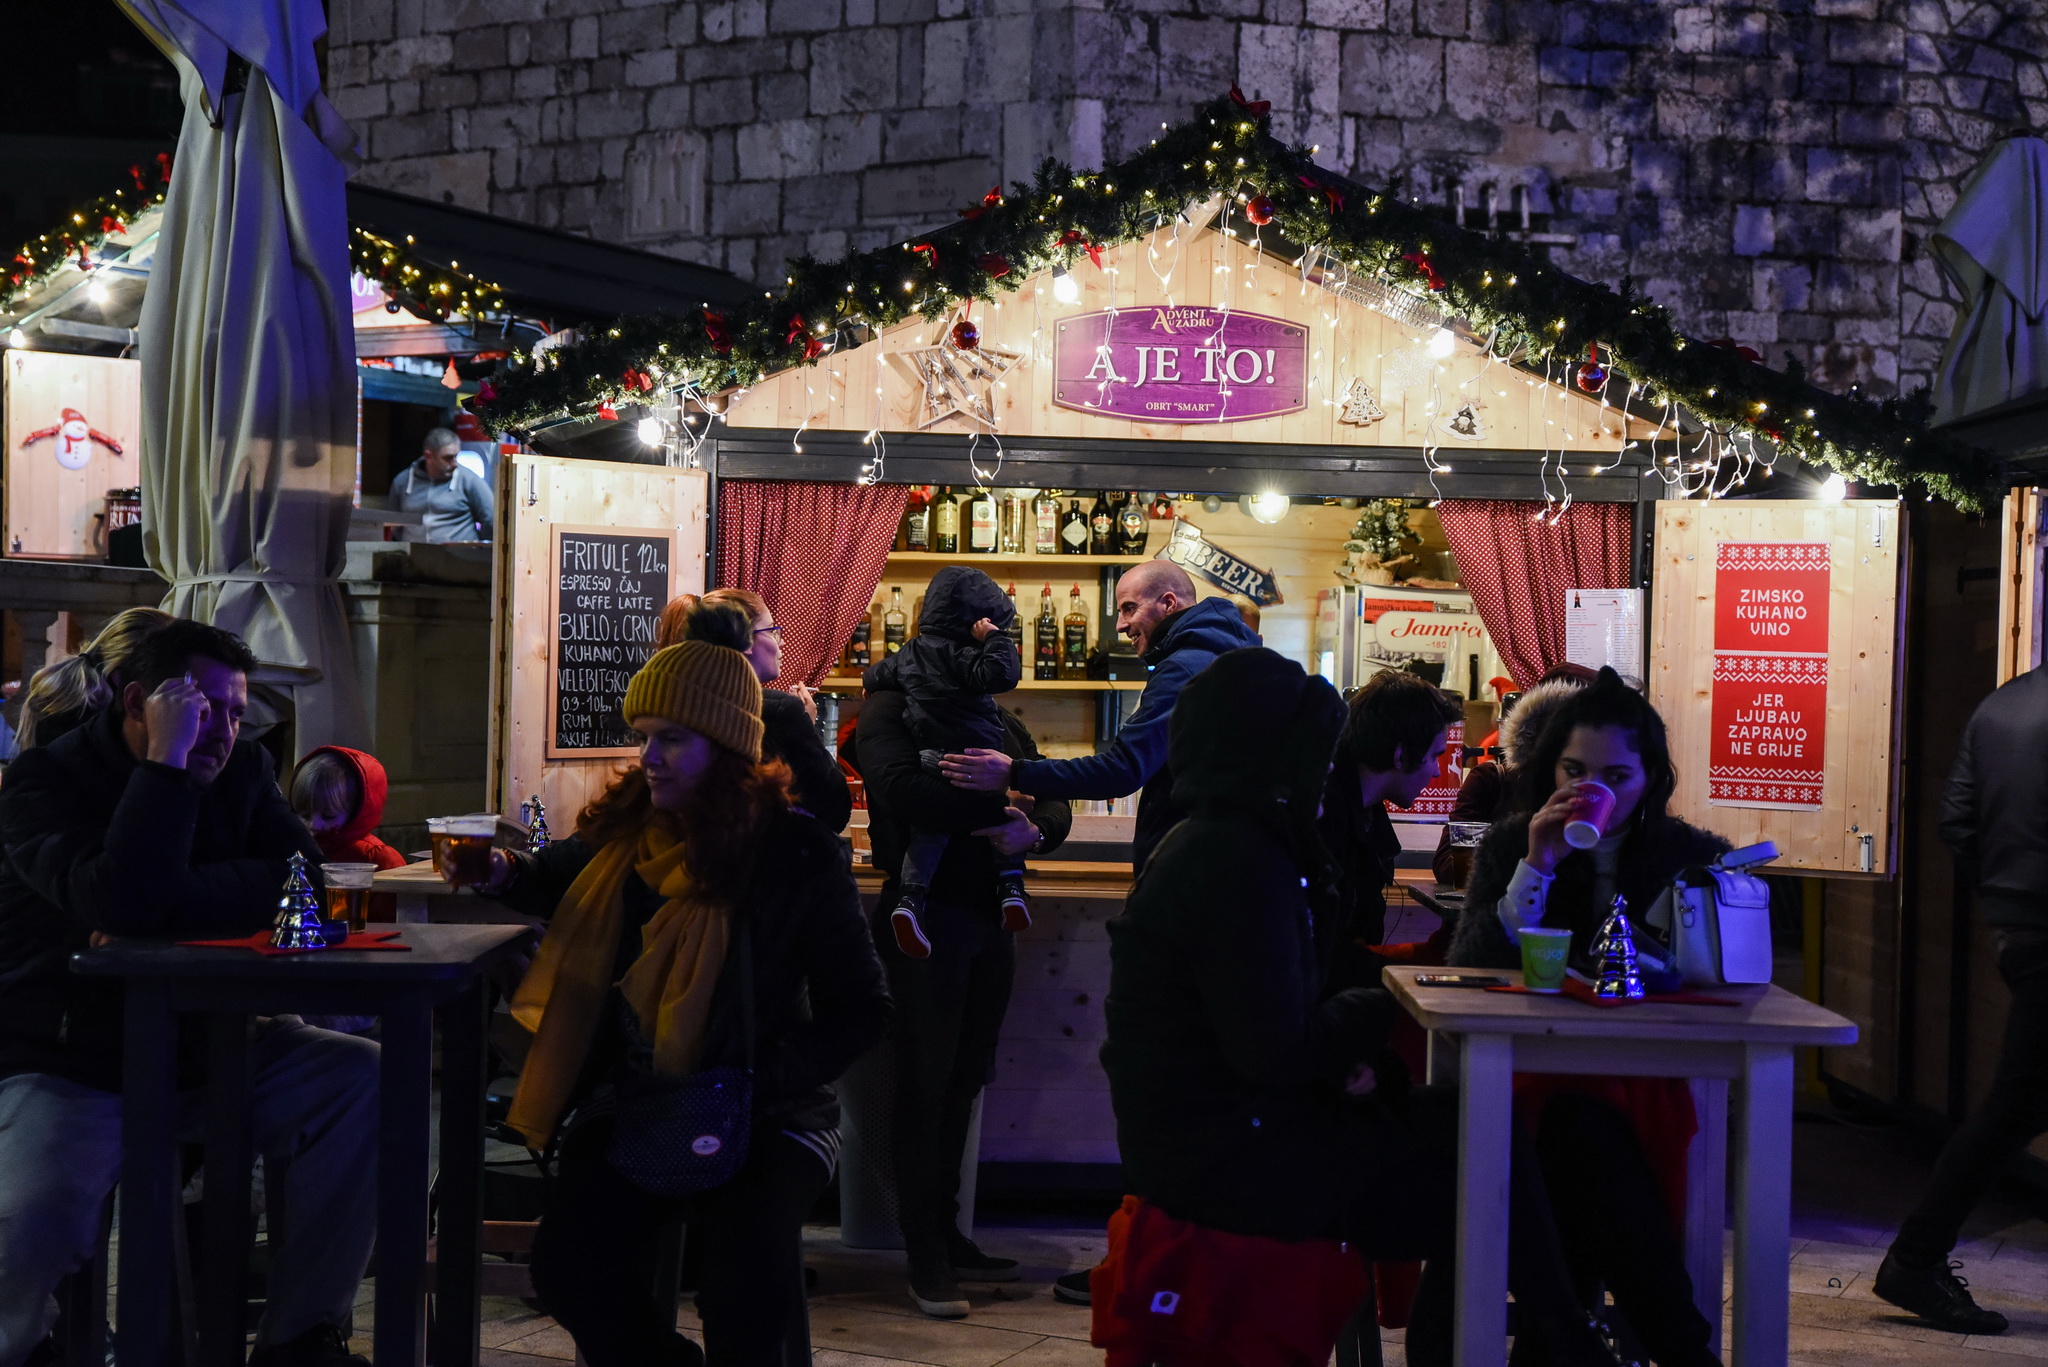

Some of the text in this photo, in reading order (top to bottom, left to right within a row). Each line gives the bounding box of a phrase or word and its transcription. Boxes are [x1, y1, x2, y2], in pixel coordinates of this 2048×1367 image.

[1151, 308, 1206, 334] ADVENT
[1176, 318, 1215, 328] ZADRU
[1085, 346, 1276, 388] A JE TO!
[1145, 402, 1172, 411] OBRT
[562, 540, 631, 574] FRITULE
[1187, 541, 1263, 597] BEER
[560, 574, 611, 591] ESPRESSO
[576, 595, 653, 610] CAFFE LATTE
[1740, 589, 1804, 604] ZIMSKO
[1736, 605, 1807, 620] KUHANO
[559, 613, 610, 642] BIJELO
[1750, 622, 1790, 636] VINO
[564, 644, 621, 664] KUHANO
[1752, 693, 1784, 708] JER
[562, 713, 592, 731] RUM
[1736, 708, 1800, 724] LJUBAV
[1728, 725, 1807, 742] ZAPRAVO
[1731, 741, 1804, 758] NE GRIJE
